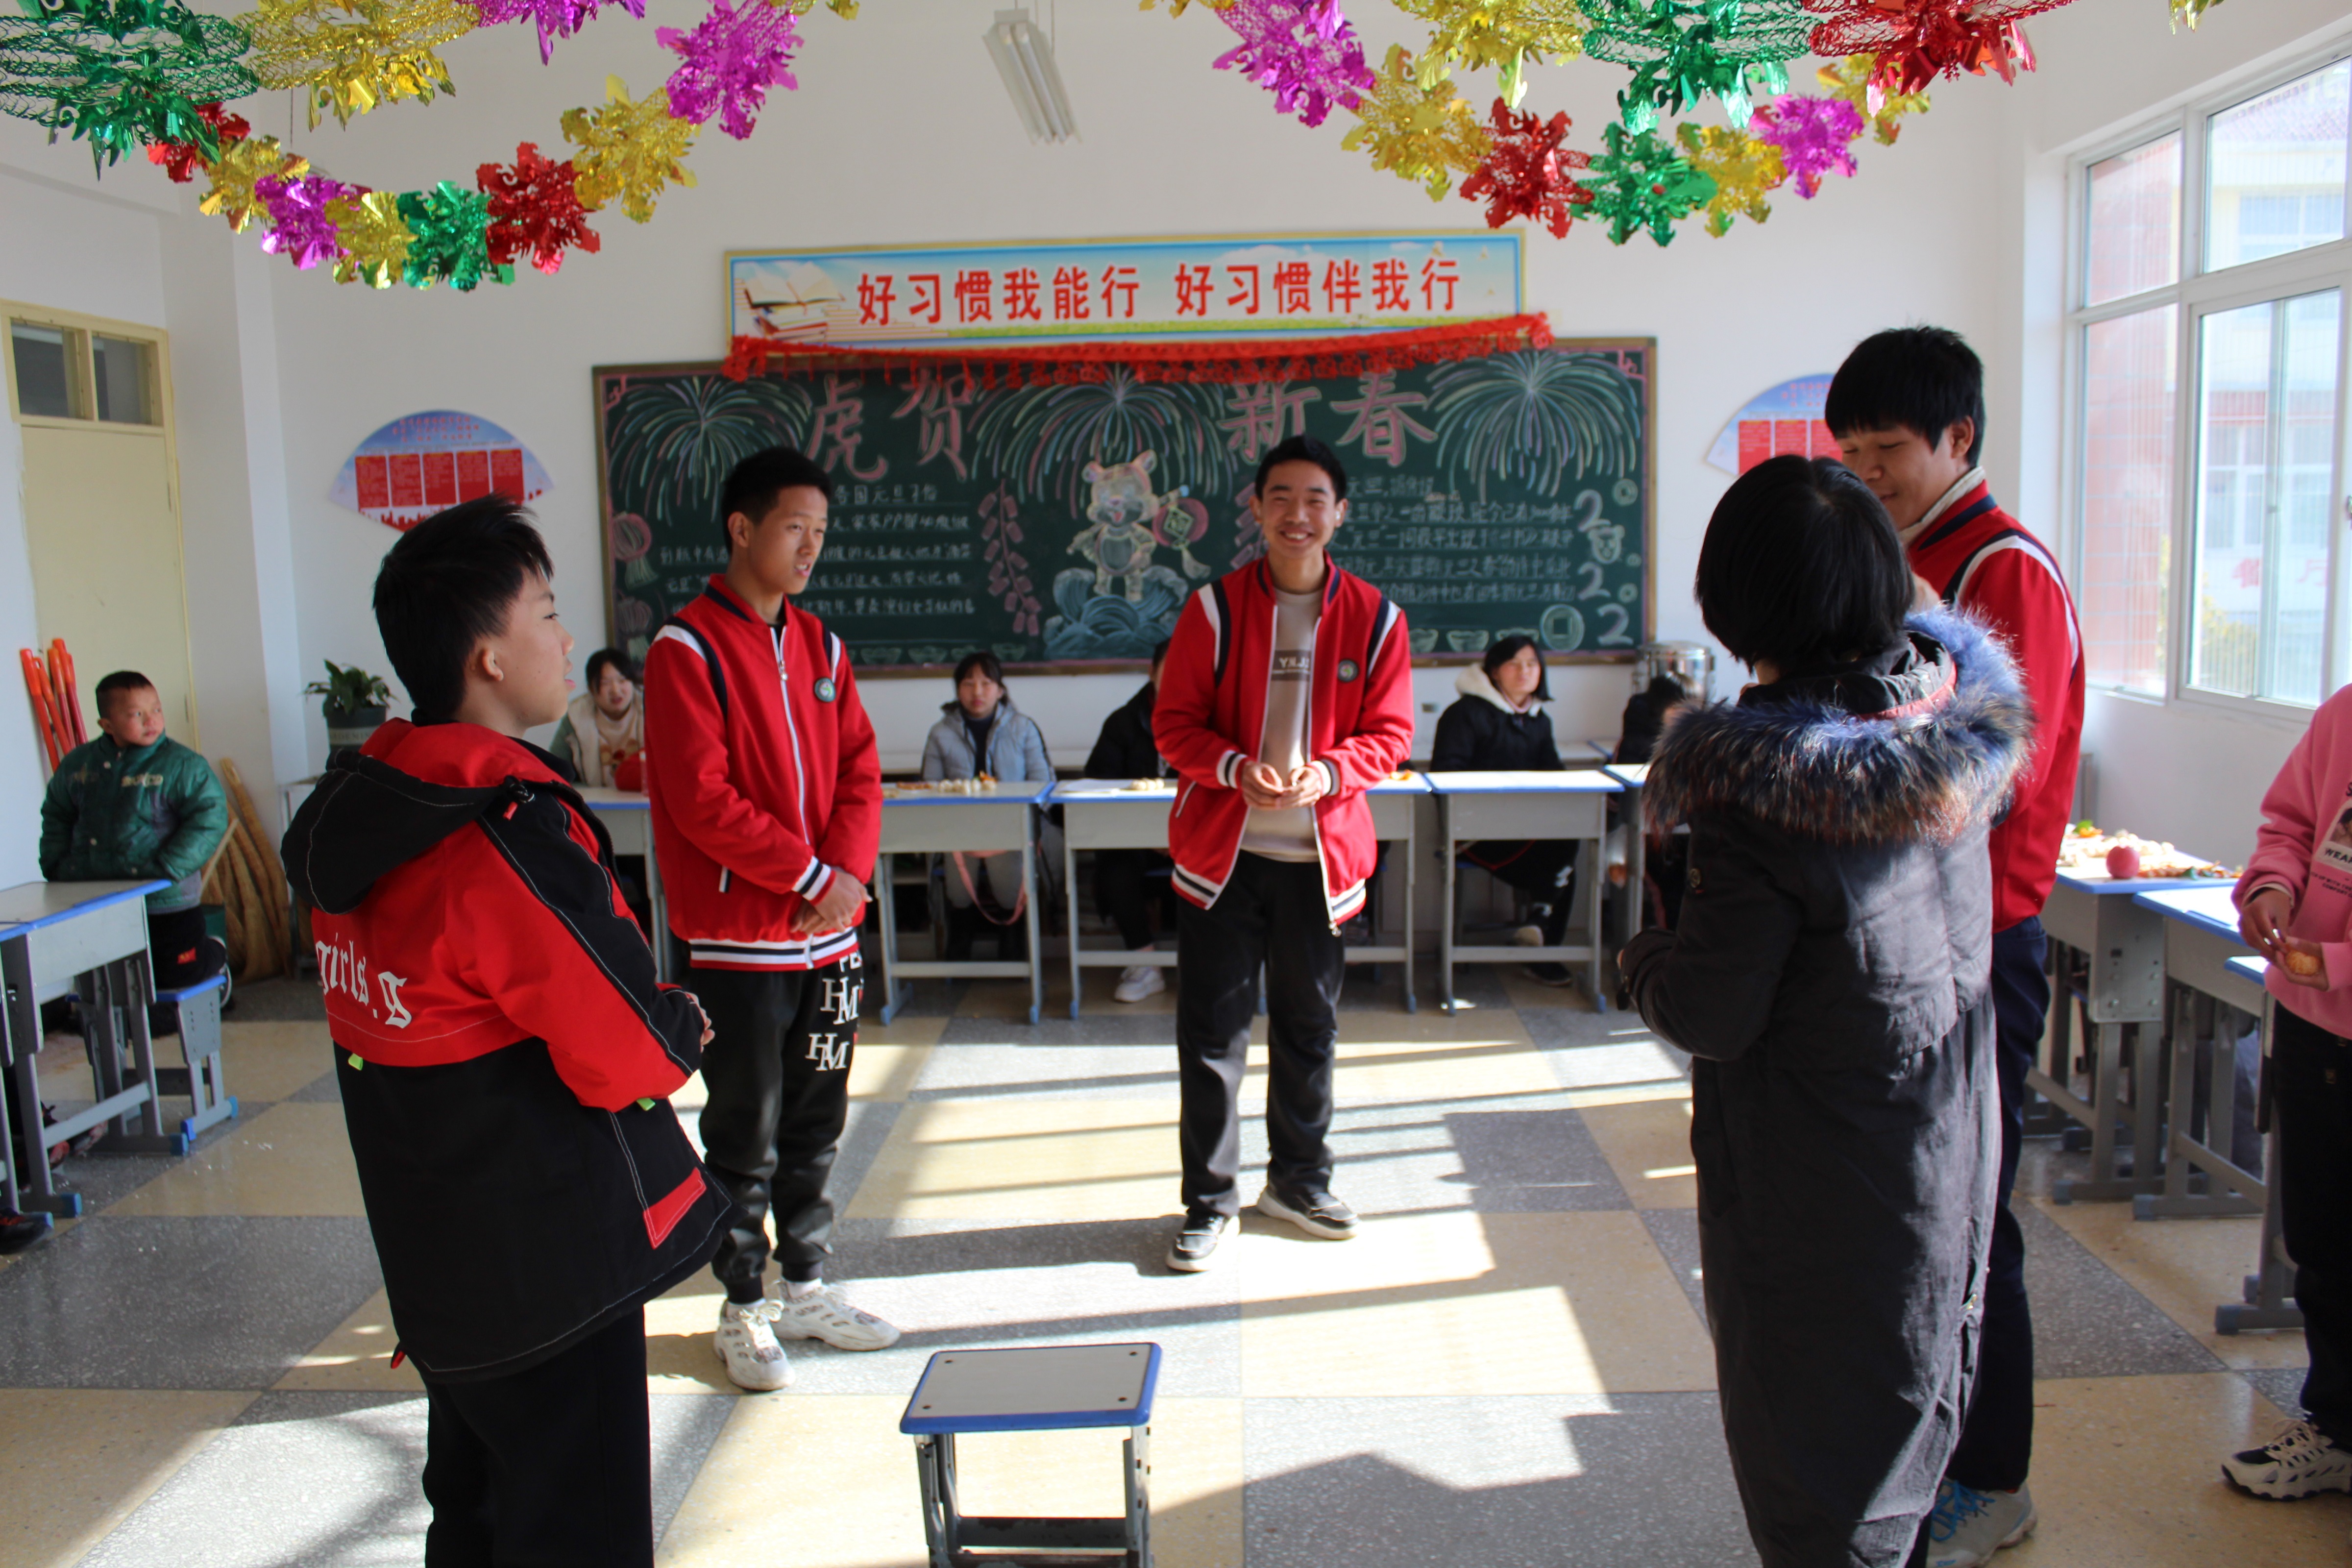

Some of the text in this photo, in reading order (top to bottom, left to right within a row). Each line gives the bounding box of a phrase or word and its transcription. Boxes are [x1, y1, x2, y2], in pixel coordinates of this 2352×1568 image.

[858, 258, 1460, 325] 好习惯我能行 好习惯伴我行
